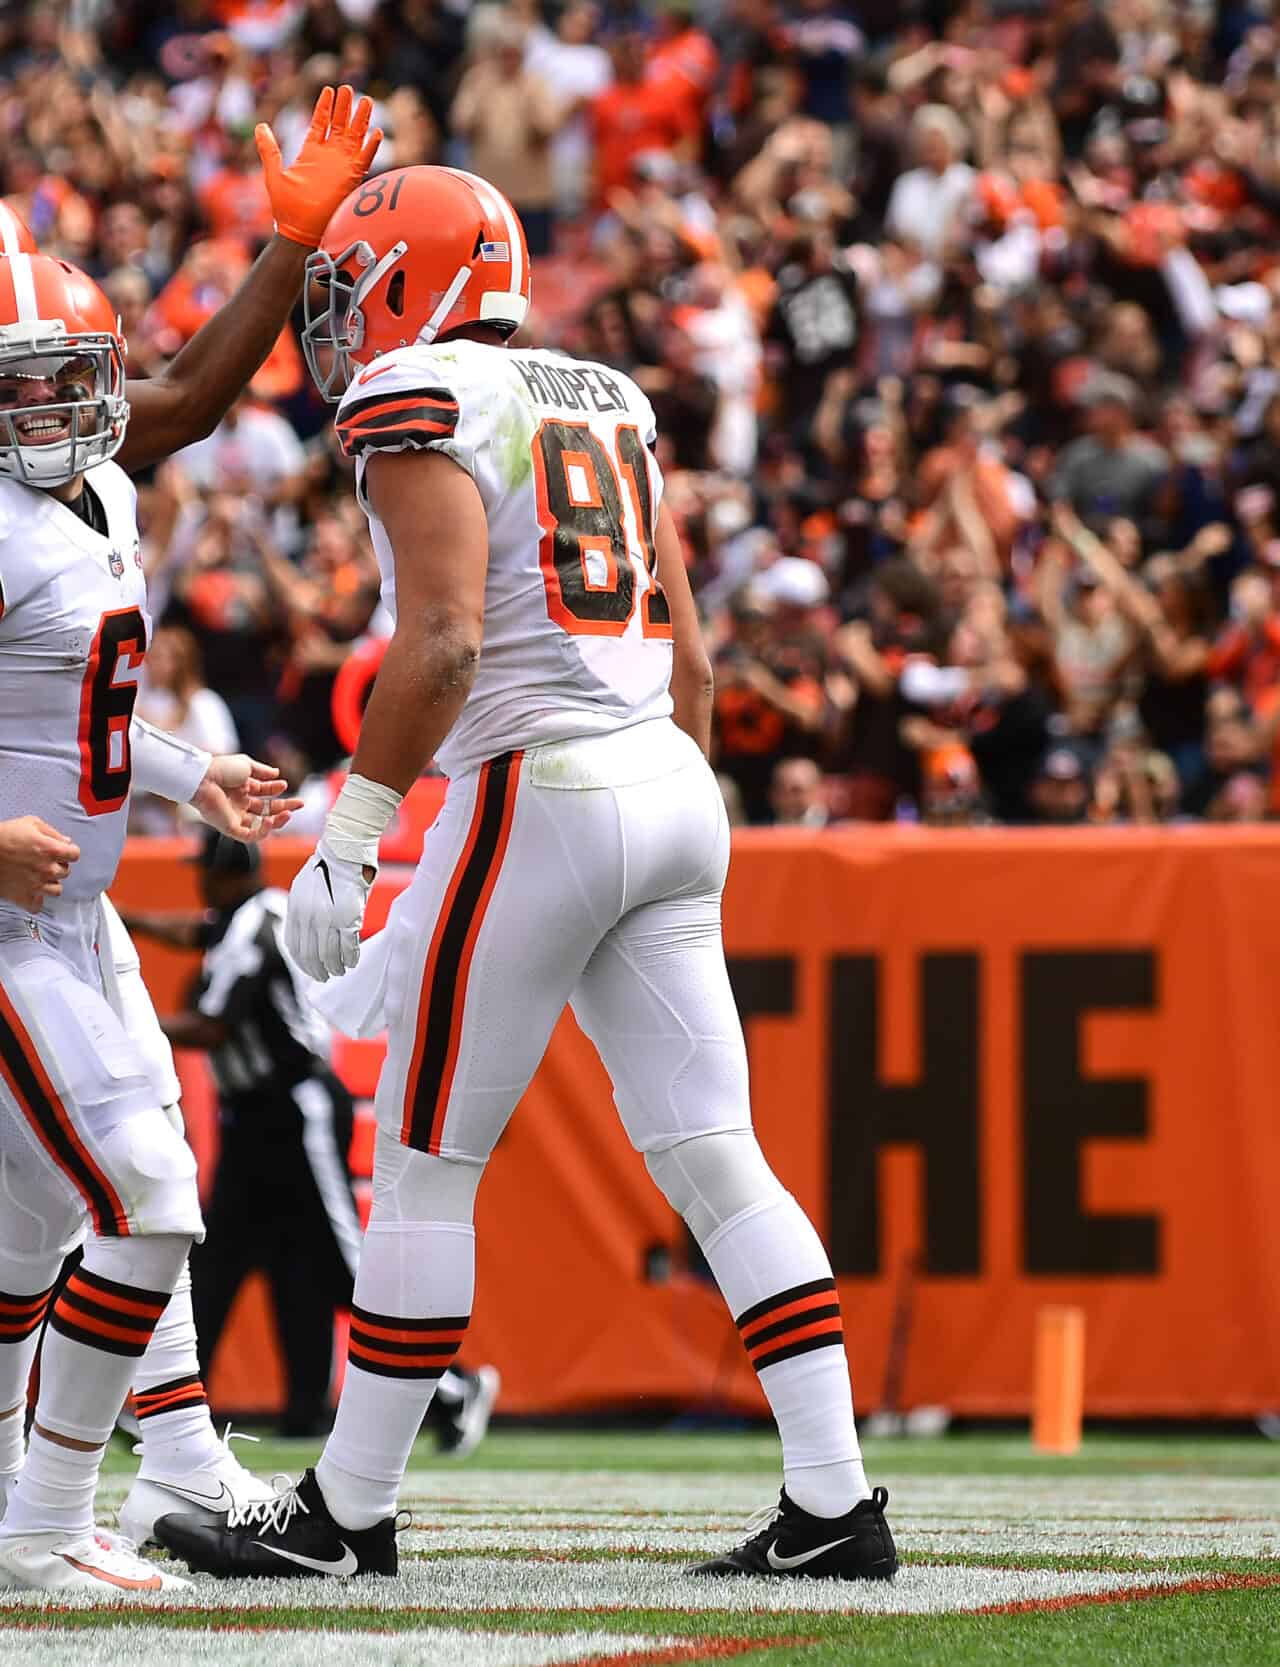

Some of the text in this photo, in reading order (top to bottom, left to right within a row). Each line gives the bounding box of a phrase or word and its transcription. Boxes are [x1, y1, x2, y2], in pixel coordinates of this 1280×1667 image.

[353, 174, 407, 217] 81
[510, 358, 630, 413] HOOPER
[531, 417, 674, 638] 81
[77, 604, 147, 817] 6
